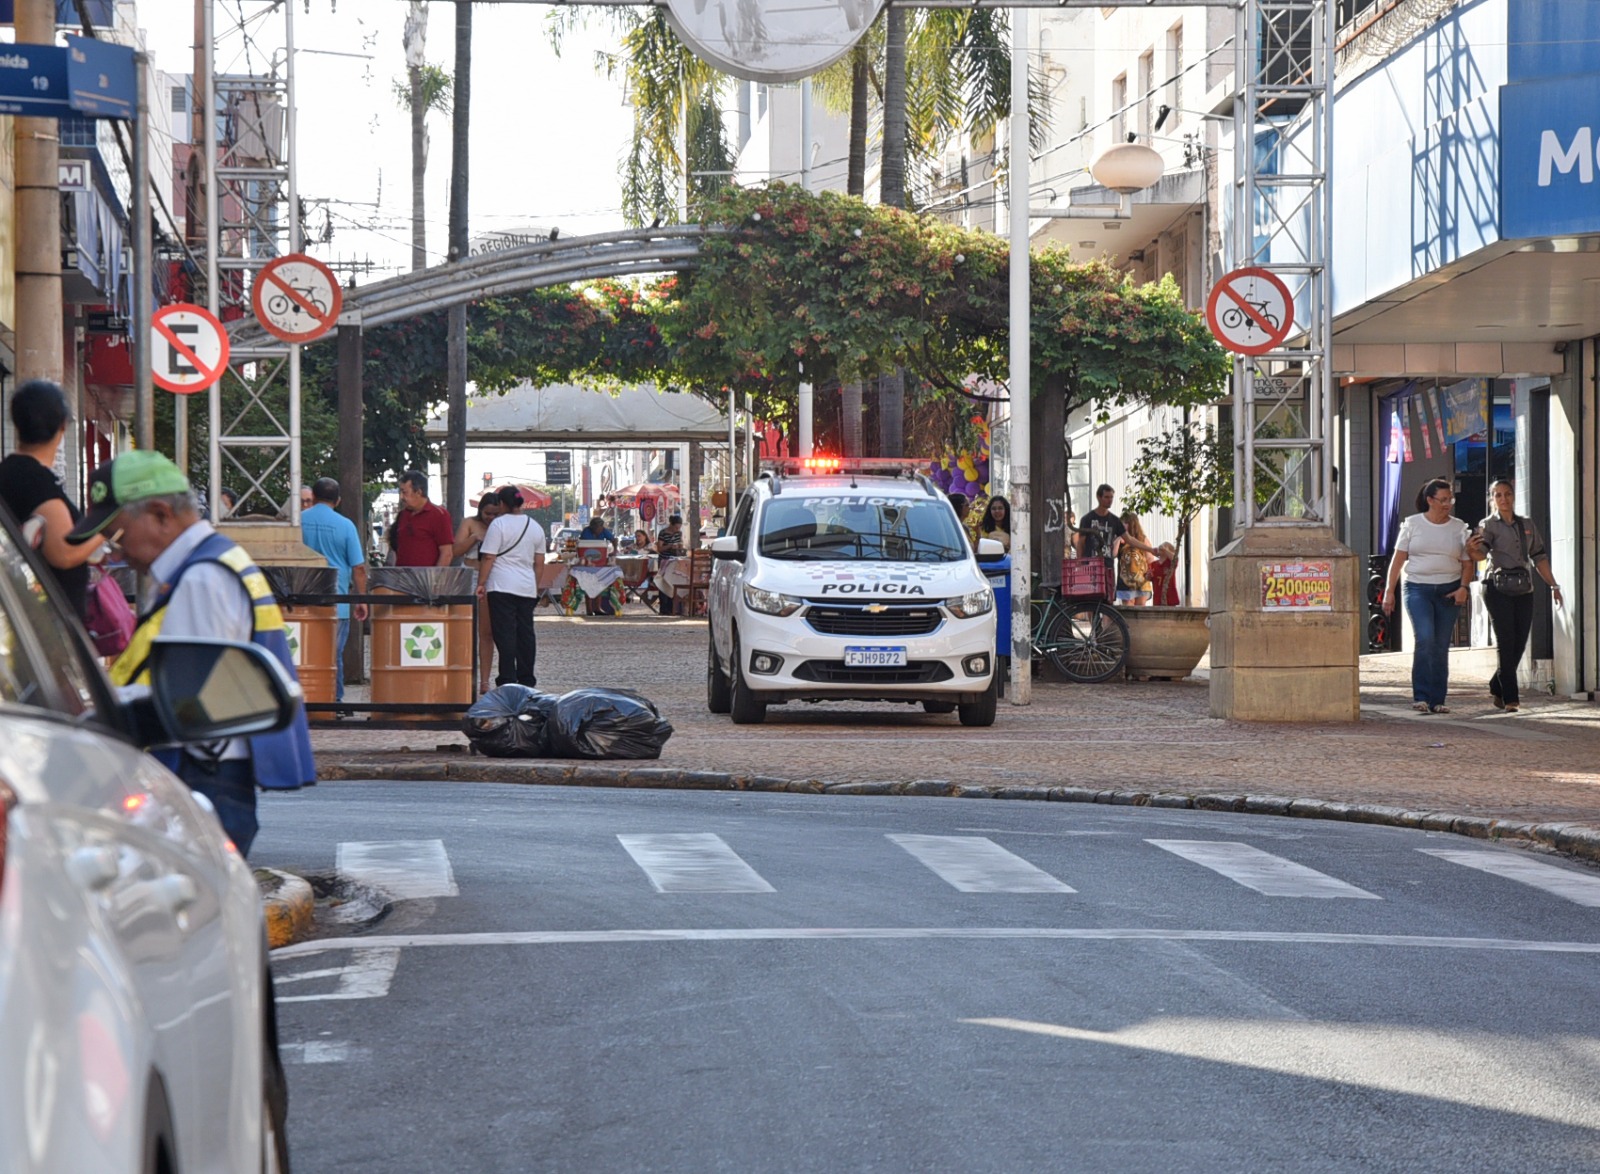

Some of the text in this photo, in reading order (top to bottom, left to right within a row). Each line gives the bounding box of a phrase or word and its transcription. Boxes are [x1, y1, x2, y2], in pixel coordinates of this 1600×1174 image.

[31, 75, 49, 91] 19
[1538, 126, 1600, 187] M
[480, 233, 530, 255] REGIONAL
[168, 324, 199, 374] E
[821, 582, 925, 595] POLÍCIA
[850, 652, 900, 664] FJH9B72
